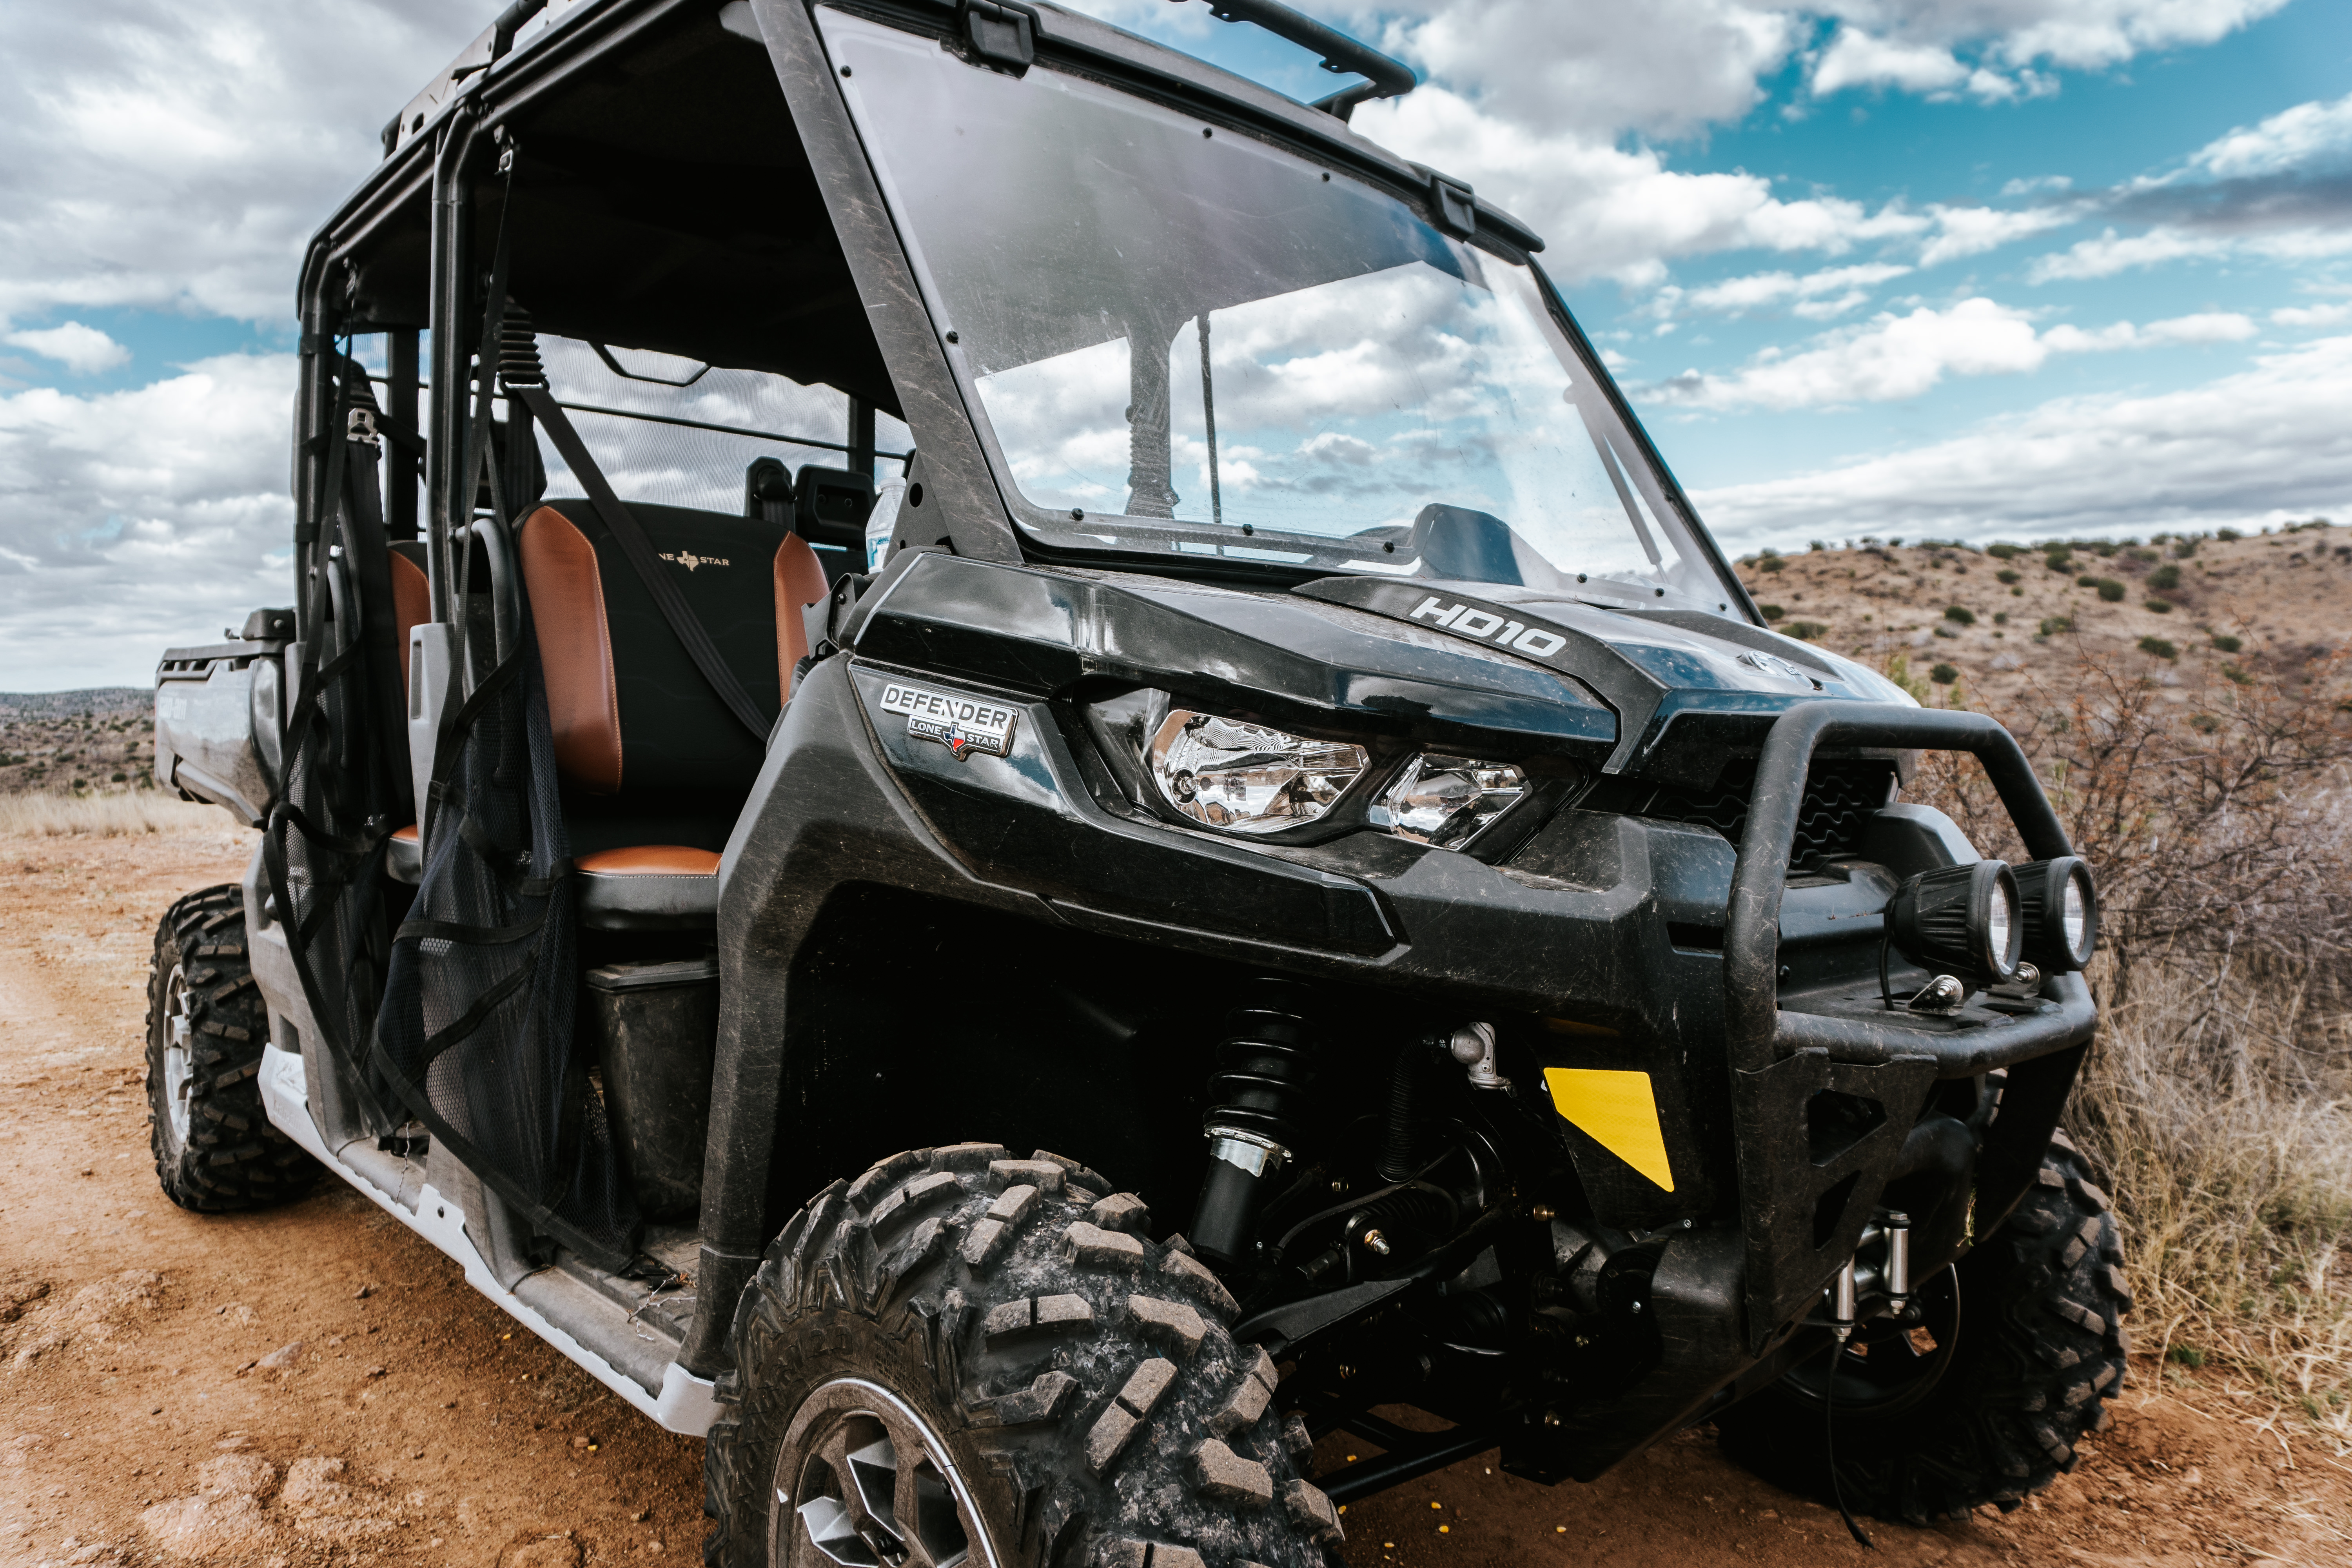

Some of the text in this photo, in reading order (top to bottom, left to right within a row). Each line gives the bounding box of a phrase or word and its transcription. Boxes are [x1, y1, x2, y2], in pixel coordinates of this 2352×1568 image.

[700, 557, 730, 566] STAR
[1409, 596, 1566, 657] HD10
[884, 687, 1008, 730] DEFENDER
[911, 720, 999, 749] LONE STAR
